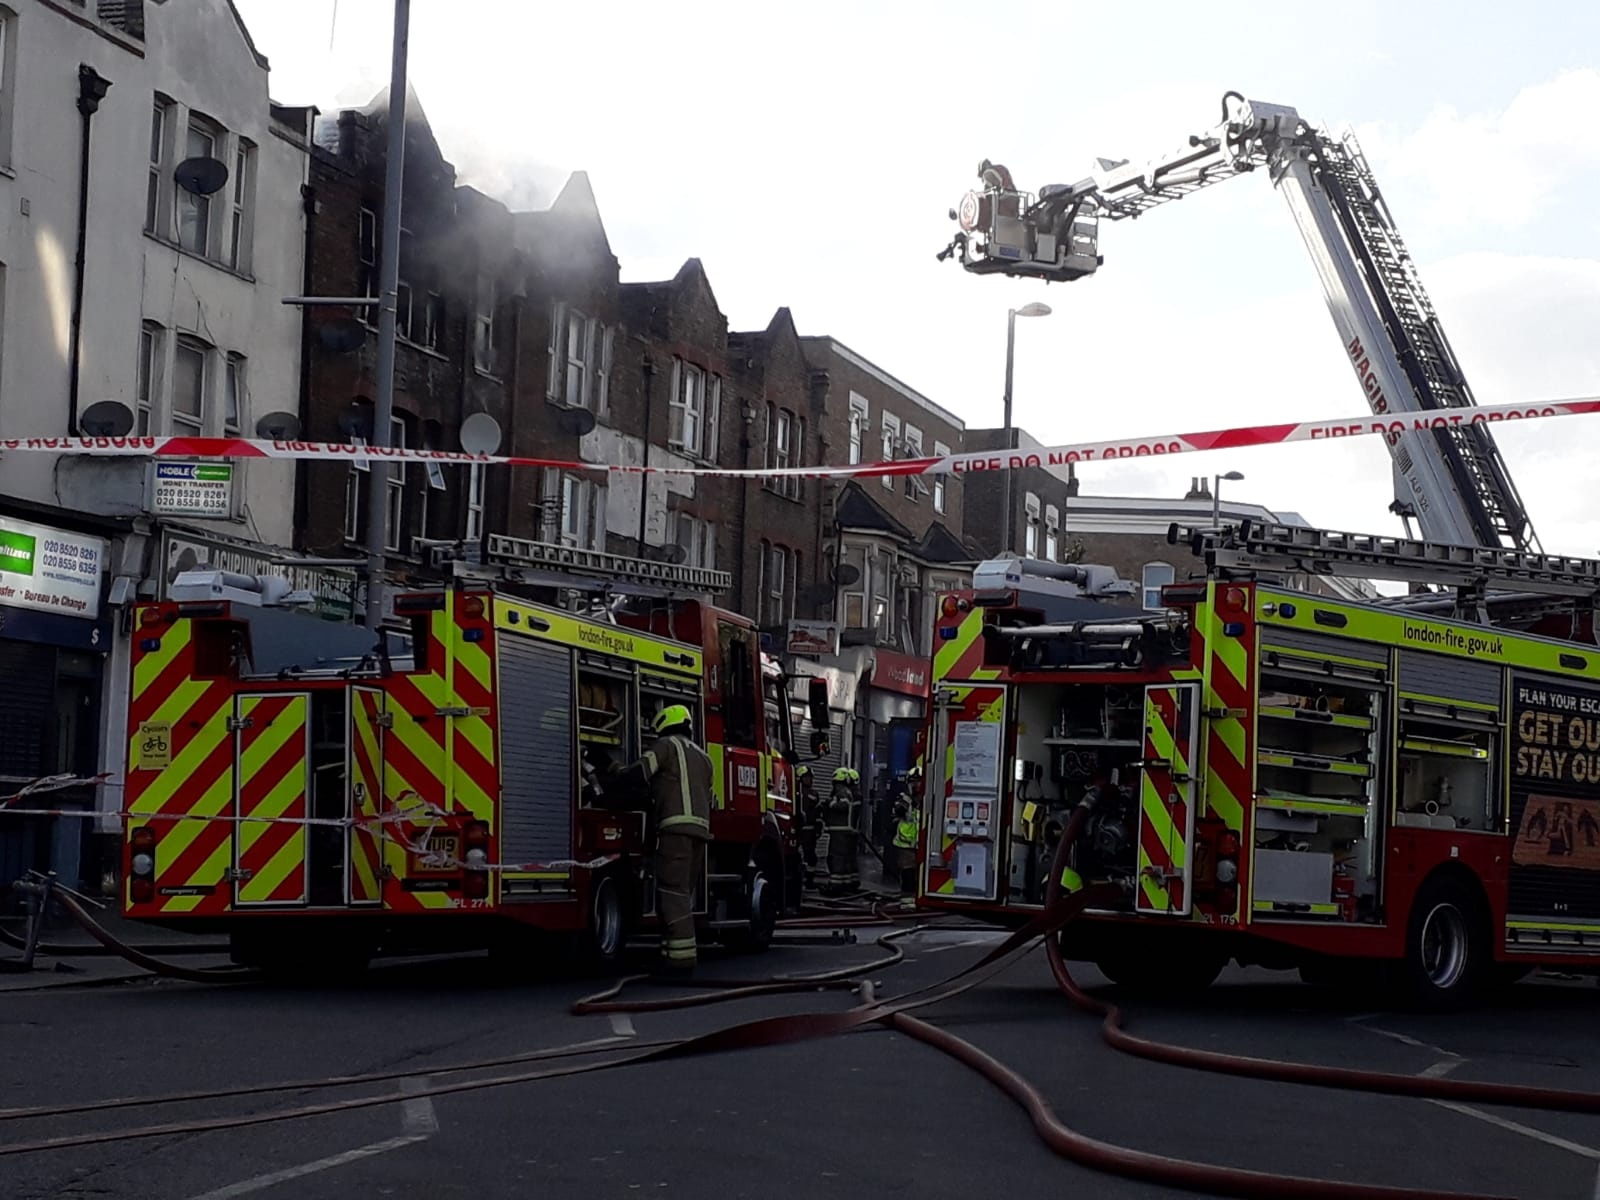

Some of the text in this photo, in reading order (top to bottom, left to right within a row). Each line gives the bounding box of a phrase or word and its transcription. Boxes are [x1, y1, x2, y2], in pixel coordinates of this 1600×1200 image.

[1348, 335, 1402, 447] MAGIRS
[159, 466, 191, 476] NOBLE
[952, 458, 1000, 473] FIRE
[1009, 454, 1041, 470] DO
[1048, 449, 1094, 466] NOT
[157, 488, 175, 497] 020
[177, 489, 201, 499] 8520
[162, 480, 225, 489] MONEY TRANSFER
[156, 497, 226, 509] 020 8558 6356
[43, 540, 59, 554] 020
[59, 543, 79, 558] 8520
[43, 554, 97, 575] 020 8558 6356
[24, 589, 51, 603] Bureau
[51, 594, 60, 606] De
[60, 594, 87, 611] Change
[578, 624, 634, 653] london-fire.gov.uk
[1403, 619, 1504, 655] london-fire.gov.uk
[1519, 687, 1547, 706] PLAN
[1549, 692, 1578, 711] YOUR
[1519, 710, 1563, 746] GET
[1516, 746, 1568, 779] STAY
